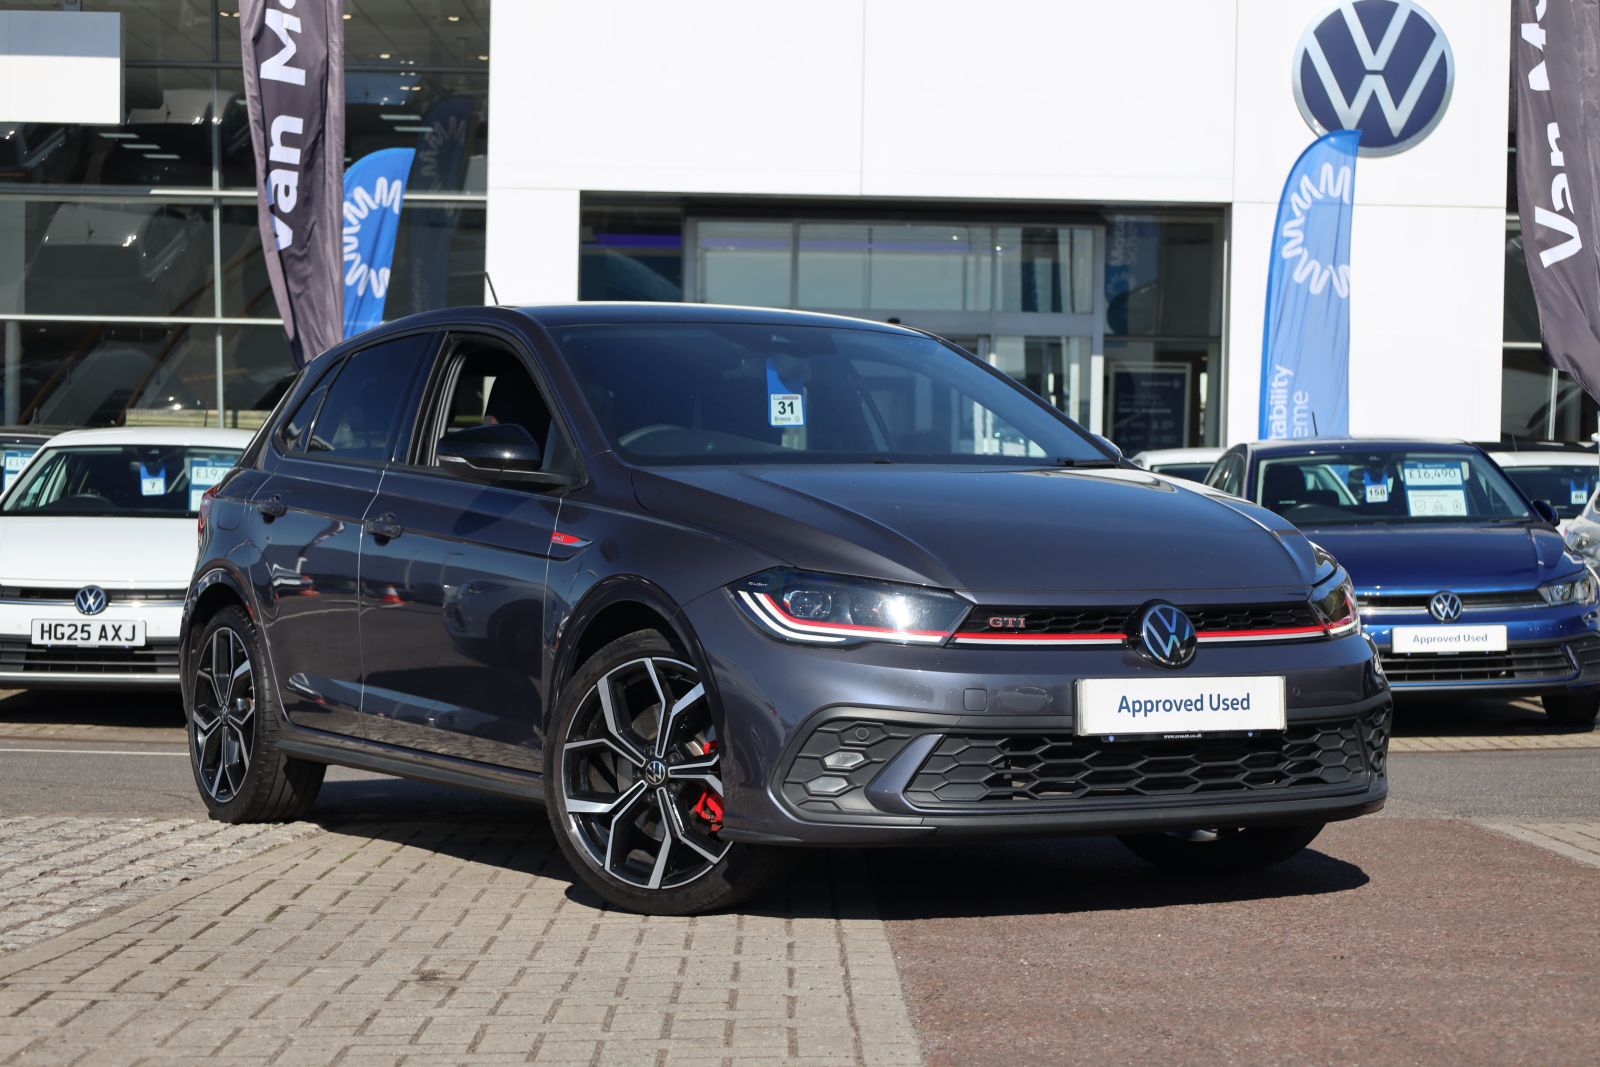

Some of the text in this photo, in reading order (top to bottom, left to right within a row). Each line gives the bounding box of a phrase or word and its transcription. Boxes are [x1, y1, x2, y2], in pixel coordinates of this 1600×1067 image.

[778, 401, 794, 415] 31
[1409, 466, 1456, 480] £16,490
[989, 616, 1026, 629] GTI
[40, 622, 136, 642] HG25 AXJ
[1412, 633, 1488, 645] Approved Used
[1117, 692, 1251, 718] Approved Used
